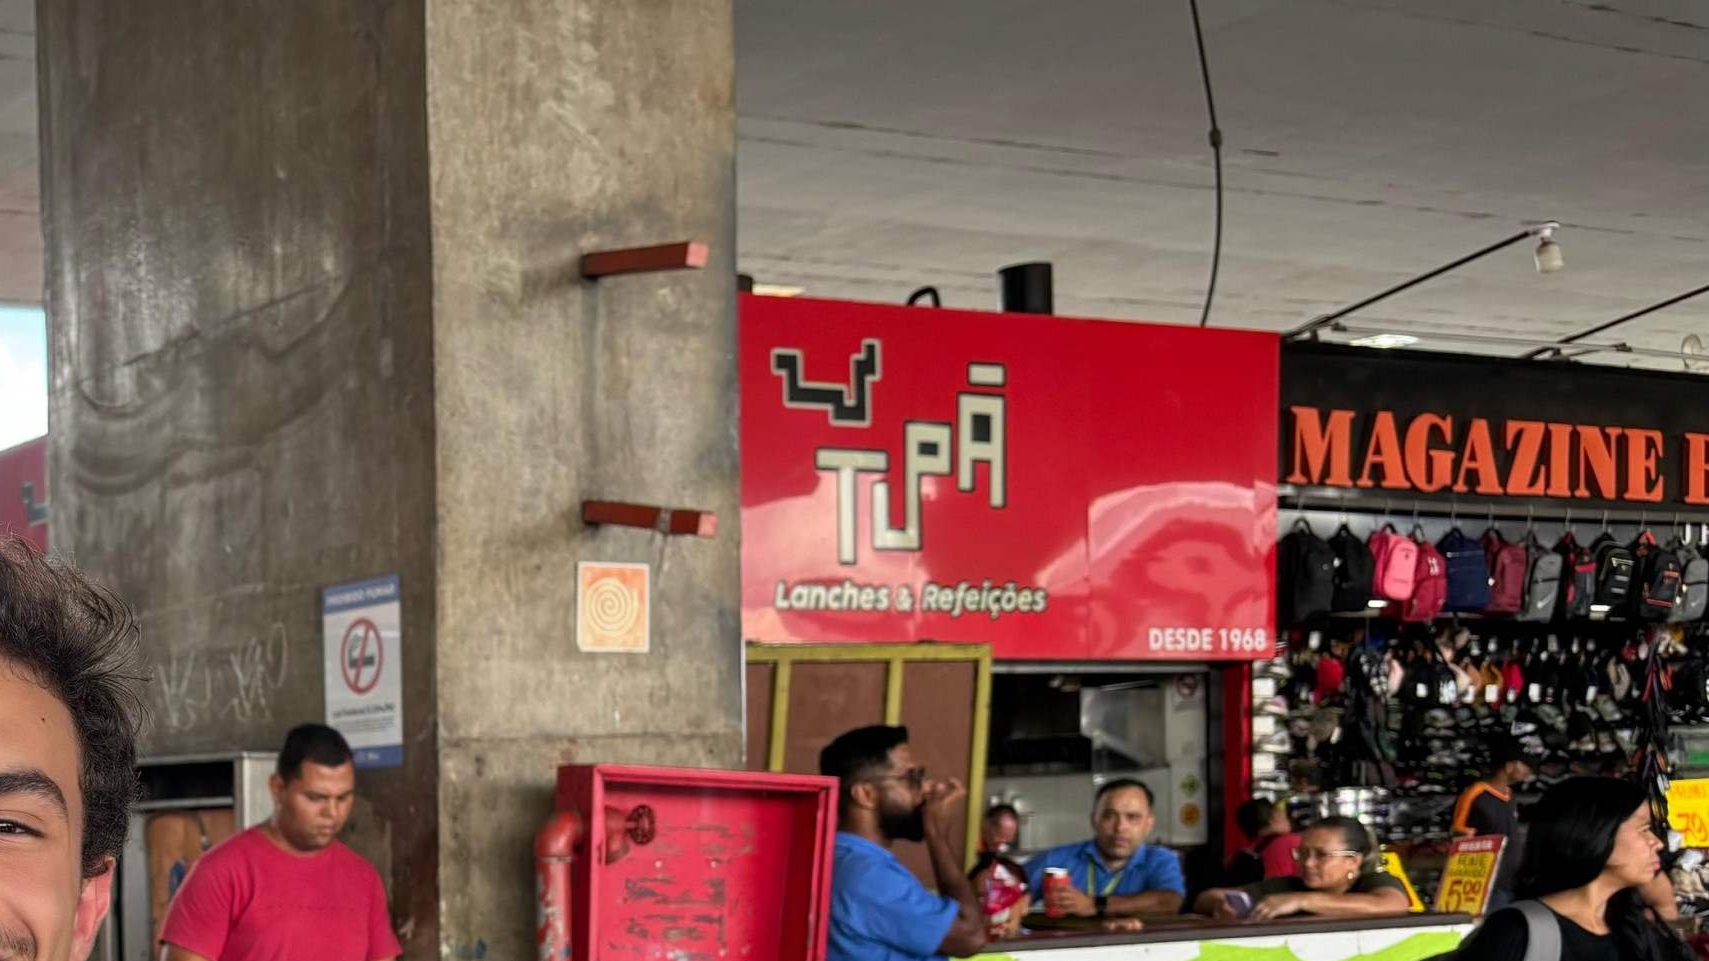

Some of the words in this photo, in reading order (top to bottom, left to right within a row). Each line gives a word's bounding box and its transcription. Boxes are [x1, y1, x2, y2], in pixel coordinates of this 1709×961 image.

[1286, 405, 1664, 503] MAGAZINE
[774, 580, 889, 612] Lanches
[896, 588, 912, 611] &
[921, 581, 1047, 620] Refeições
[1149, 628, 1214, 651] DESDE
[1219, 630, 1267, 653] 1968
